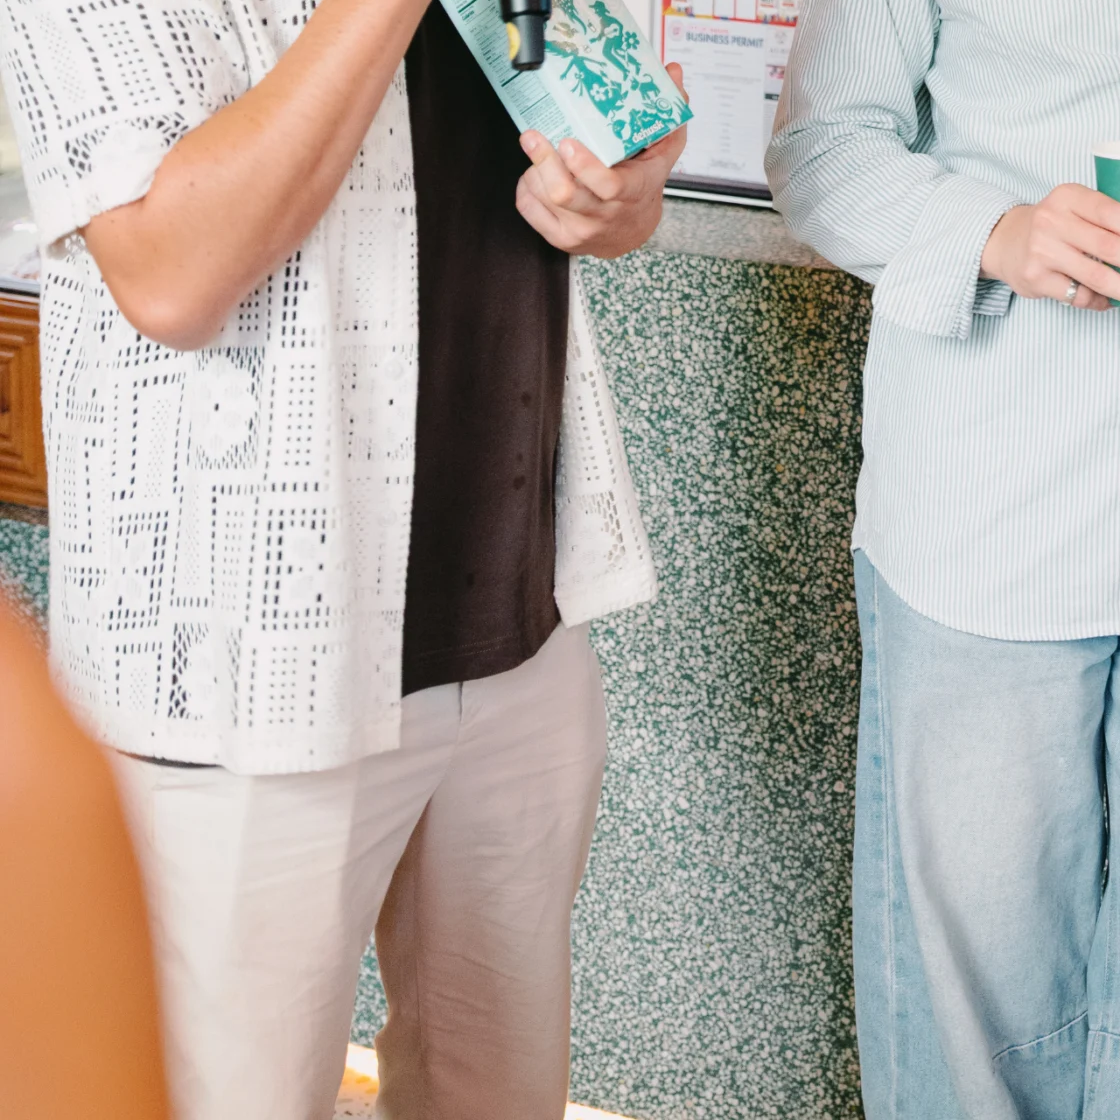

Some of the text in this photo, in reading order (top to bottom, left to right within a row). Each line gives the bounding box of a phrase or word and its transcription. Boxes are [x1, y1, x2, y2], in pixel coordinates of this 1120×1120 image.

[685, 32, 764, 48] BUSINESS PERMIT
[632, 120, 665, 143] dehusk
